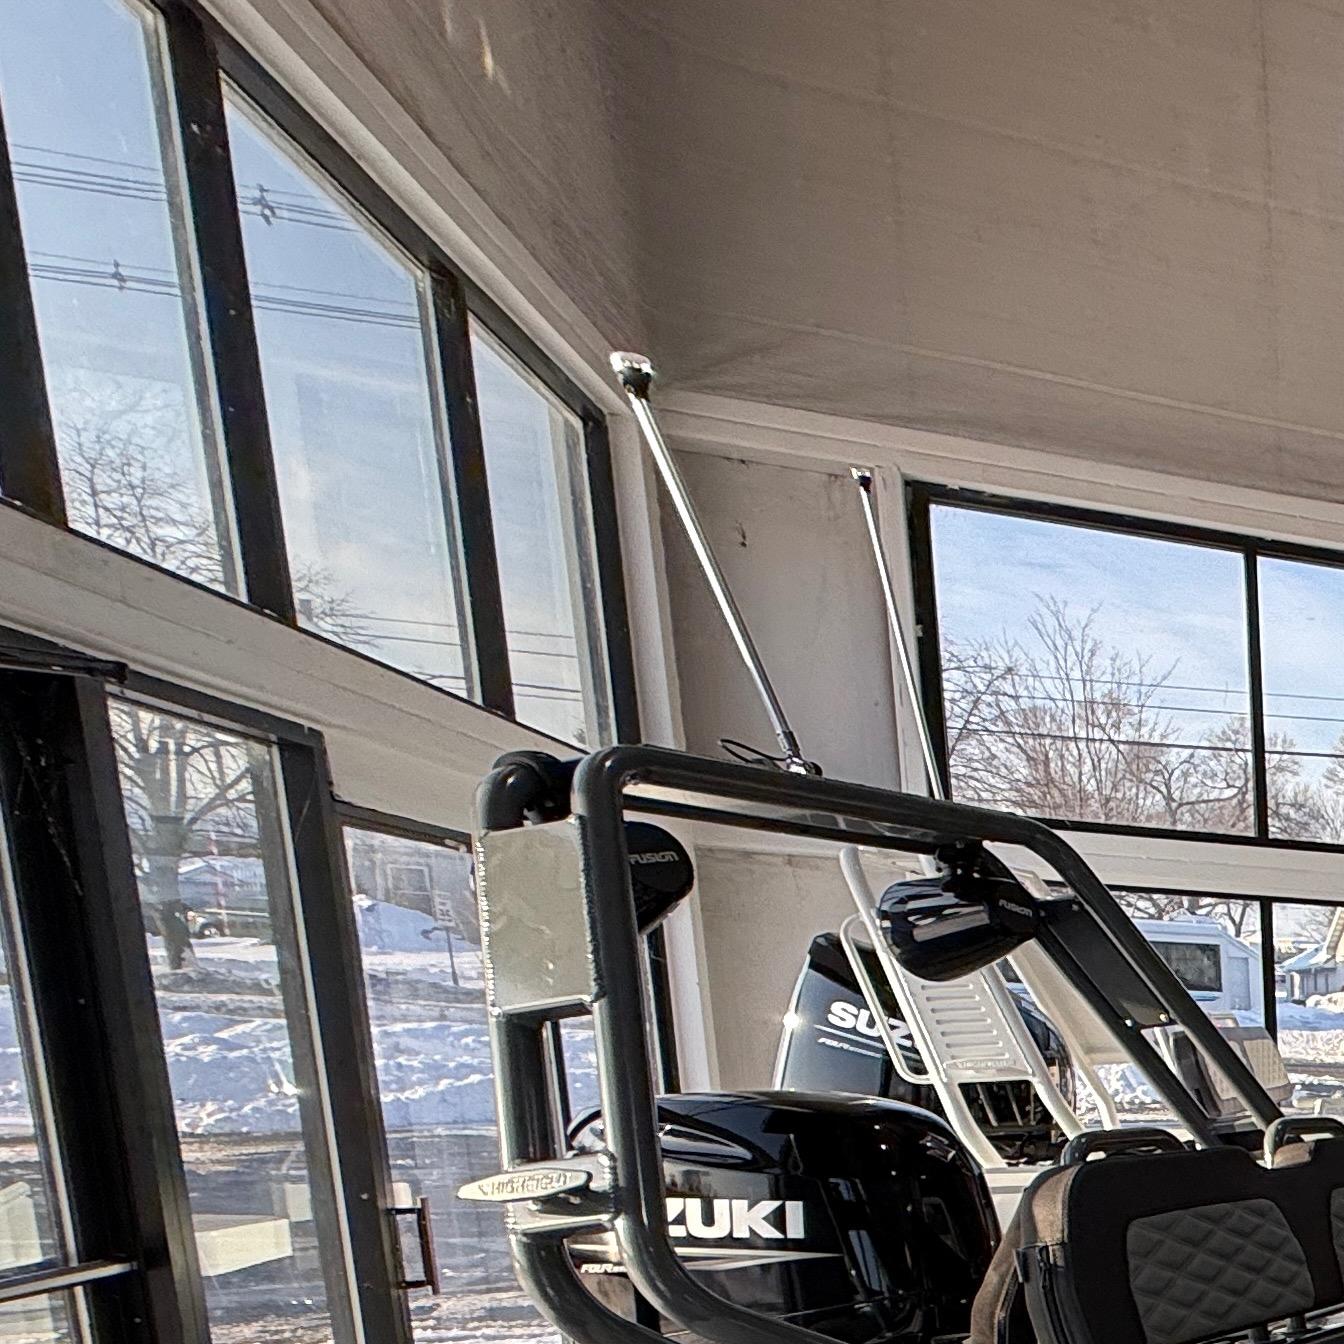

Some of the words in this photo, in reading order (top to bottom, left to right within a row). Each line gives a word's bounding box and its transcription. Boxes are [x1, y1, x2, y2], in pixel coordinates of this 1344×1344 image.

[628, 851, 679, 865] FUSION
[827, 1001, 913, 1048] SUZ
[665, 1197, 805, 1239] ZUKI
